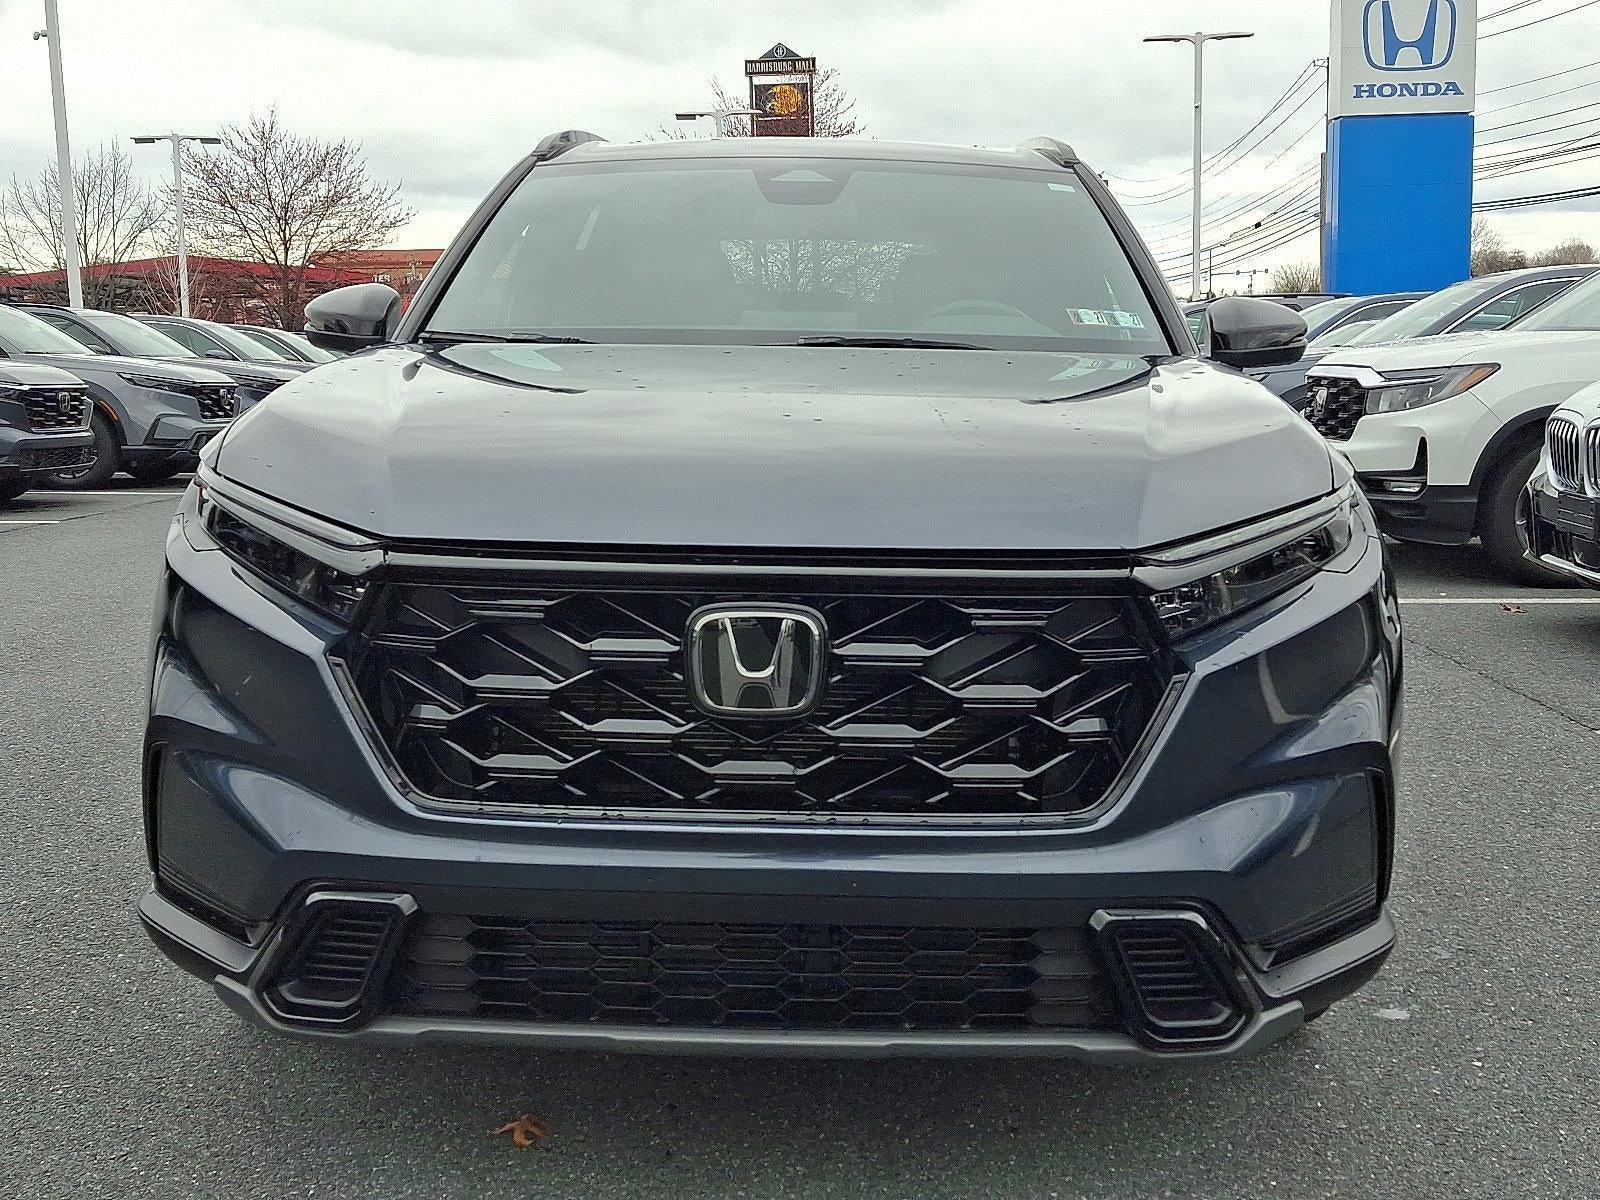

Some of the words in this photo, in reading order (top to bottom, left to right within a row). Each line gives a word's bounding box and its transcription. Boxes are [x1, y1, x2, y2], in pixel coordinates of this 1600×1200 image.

[746, 61, 792, 73] HARRISBURG
[795, 60, 815, 71] MALL
[1353, 82, 1464, 98] HONDA
